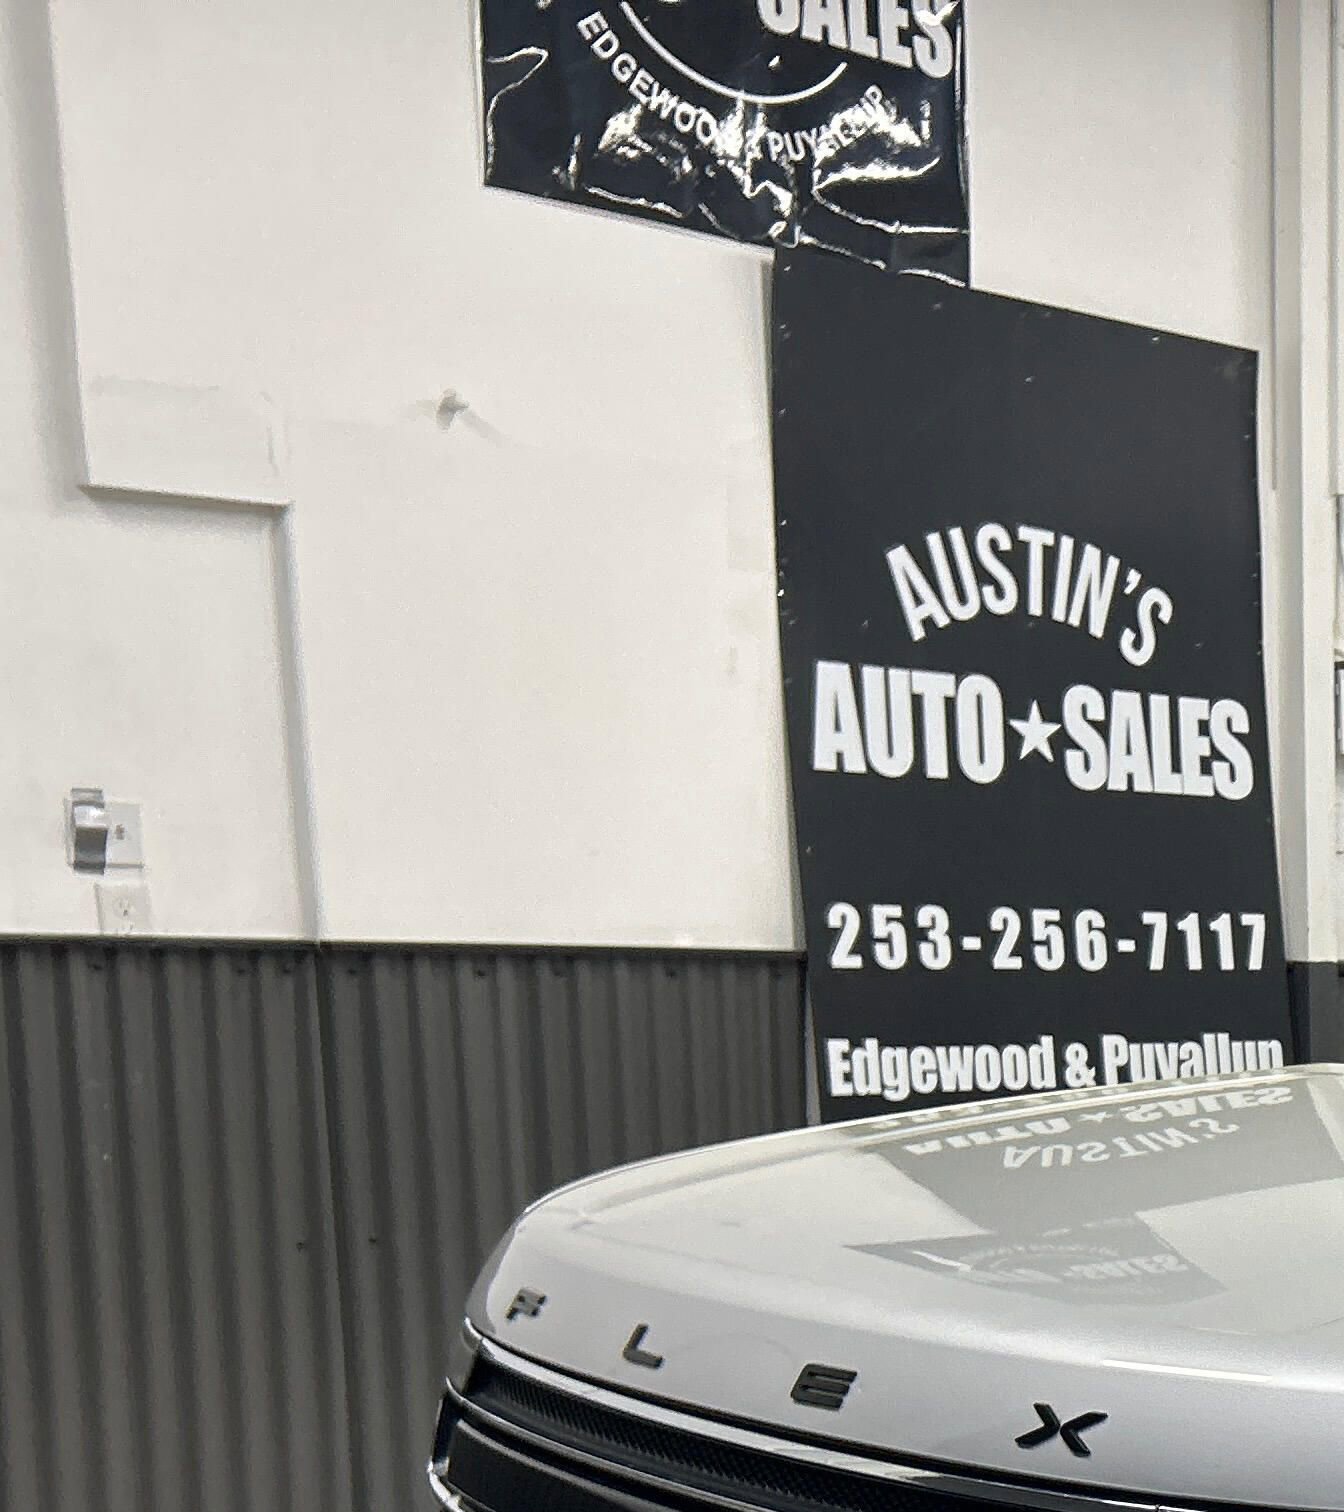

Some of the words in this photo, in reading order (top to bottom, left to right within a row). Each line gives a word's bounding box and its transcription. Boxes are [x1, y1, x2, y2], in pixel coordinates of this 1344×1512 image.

[886, 523, 1173, 667] AUSTIN'S
[812, 661, 1005, 783] AUTO
[1061, 684, 1254, 801] SALES
[828, 901, 1266, 972] 253-256-7117
[825, 1034, 1056, 1102] Edgewood
[1064, 1041, 1097, 1088] &
[506, 1286, 1109, 1457] FLEX
